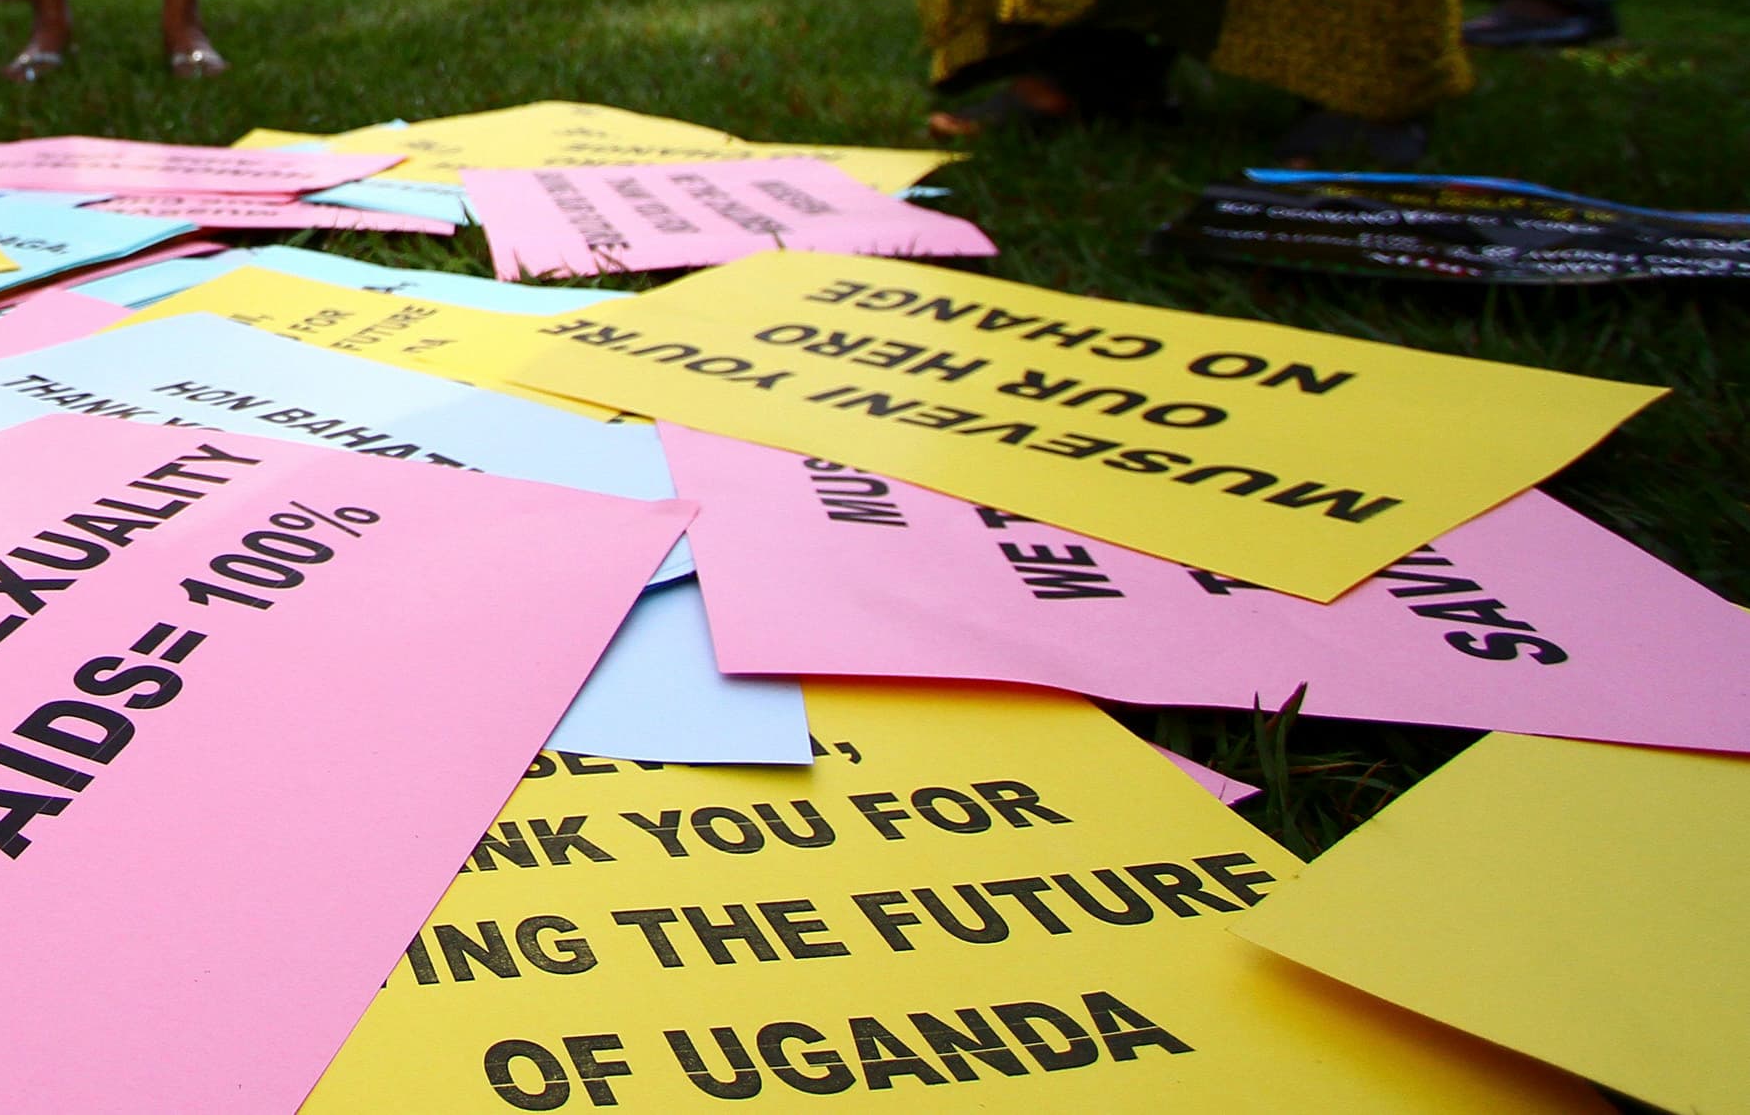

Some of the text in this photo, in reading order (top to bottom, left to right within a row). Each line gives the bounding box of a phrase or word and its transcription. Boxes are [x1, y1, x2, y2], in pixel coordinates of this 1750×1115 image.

[288, 309, 356, 334] FOR
[330, 305, 440, 352] FUTURE
[804, 280, 1356, 394] NO CHANGE
[1, 374, 160, 419] THANK
[152, 381, 274, 411] HON
[537, 319, 1403, 523] MUSEVENI YOU'RE
[754, 325, 1228, 428] OUR HERO
[180, 499, 382, 611] 100%
[997, 542, 1126, 599] WE
[618, 799, 836, 857] YOU
[847, 779, 1072, 842] FOR
[611, 899, 850, 968] THE
[851, 852, 1277, 953] FUTURE
[482, 990, 1198, 1112] OF UGANDA
